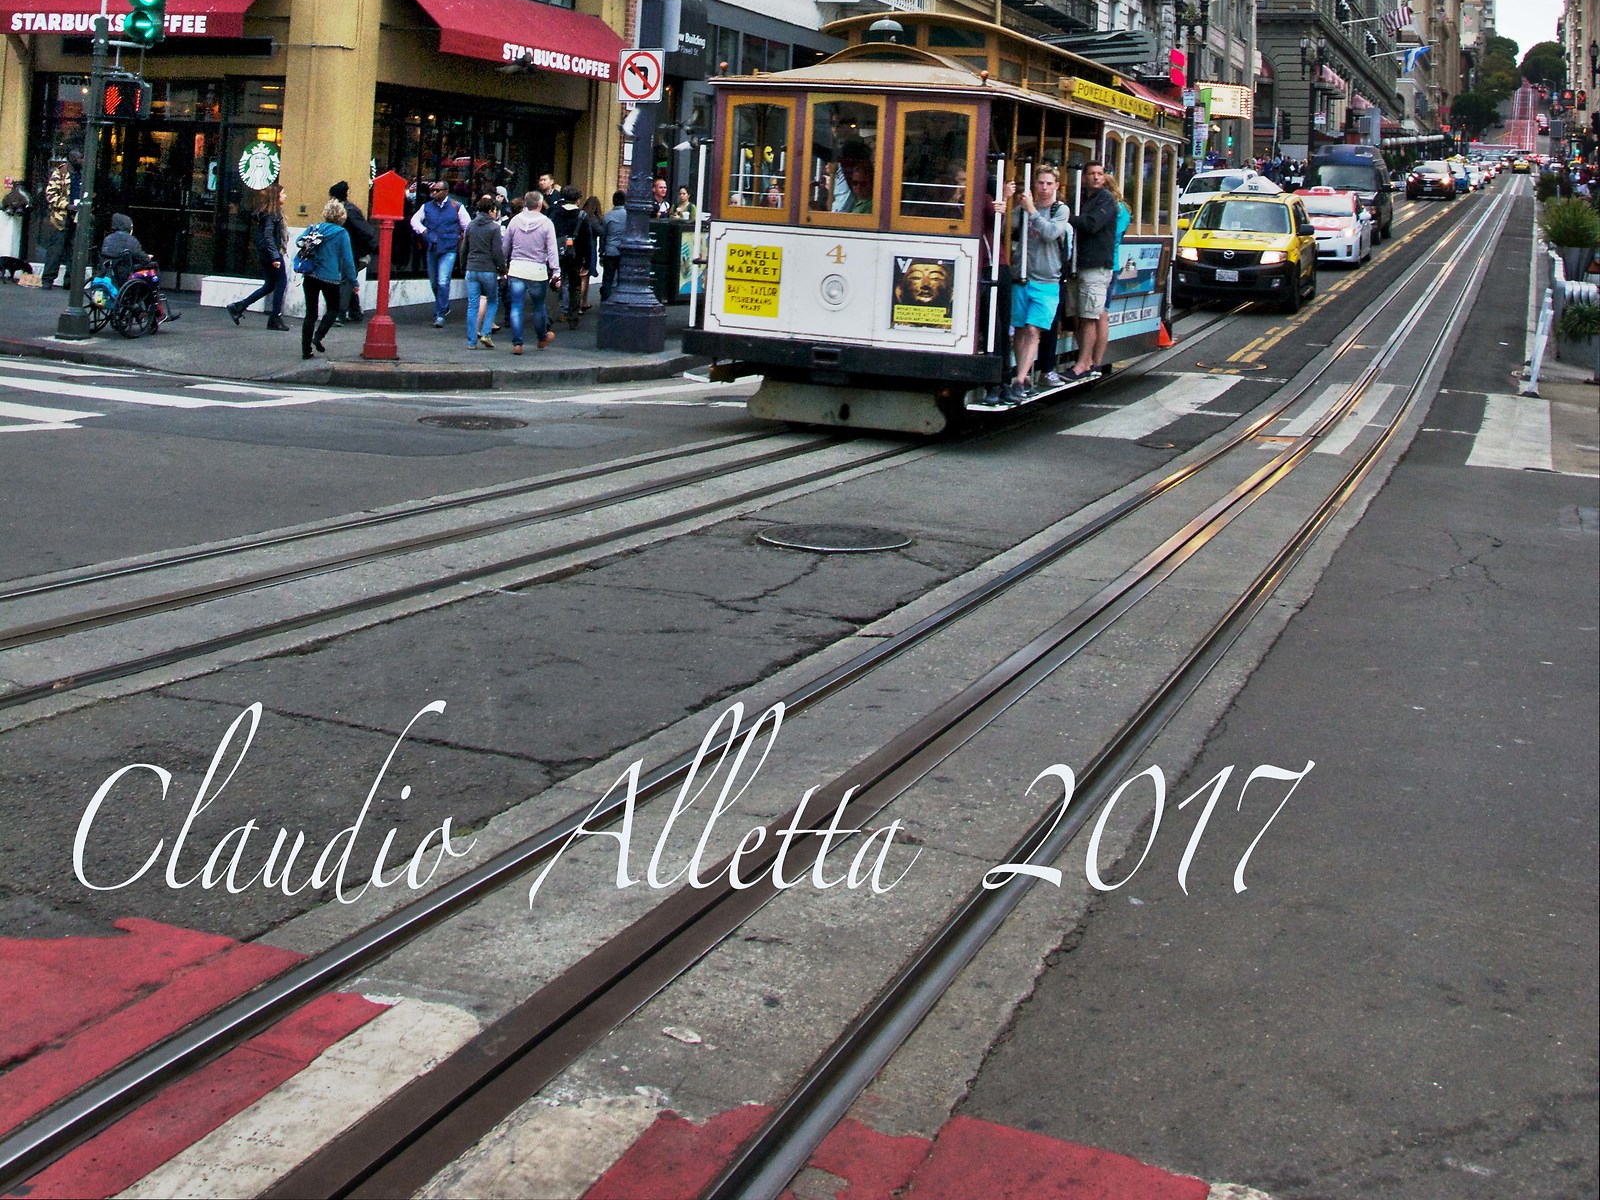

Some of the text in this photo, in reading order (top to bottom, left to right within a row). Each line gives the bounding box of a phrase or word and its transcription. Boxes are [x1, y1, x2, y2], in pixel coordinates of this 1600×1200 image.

[685, 32, 706, 49] Building
[571, 56, 611, 79] COFFEE
[1077, 82, 1109, 103] POWELL
[729, 248, 779, 260] POWELL
[825, 244, 847, 265] 4
[727, 265, 779, 276] MARKET
[751, 286, 778, 296] TAYLOR
